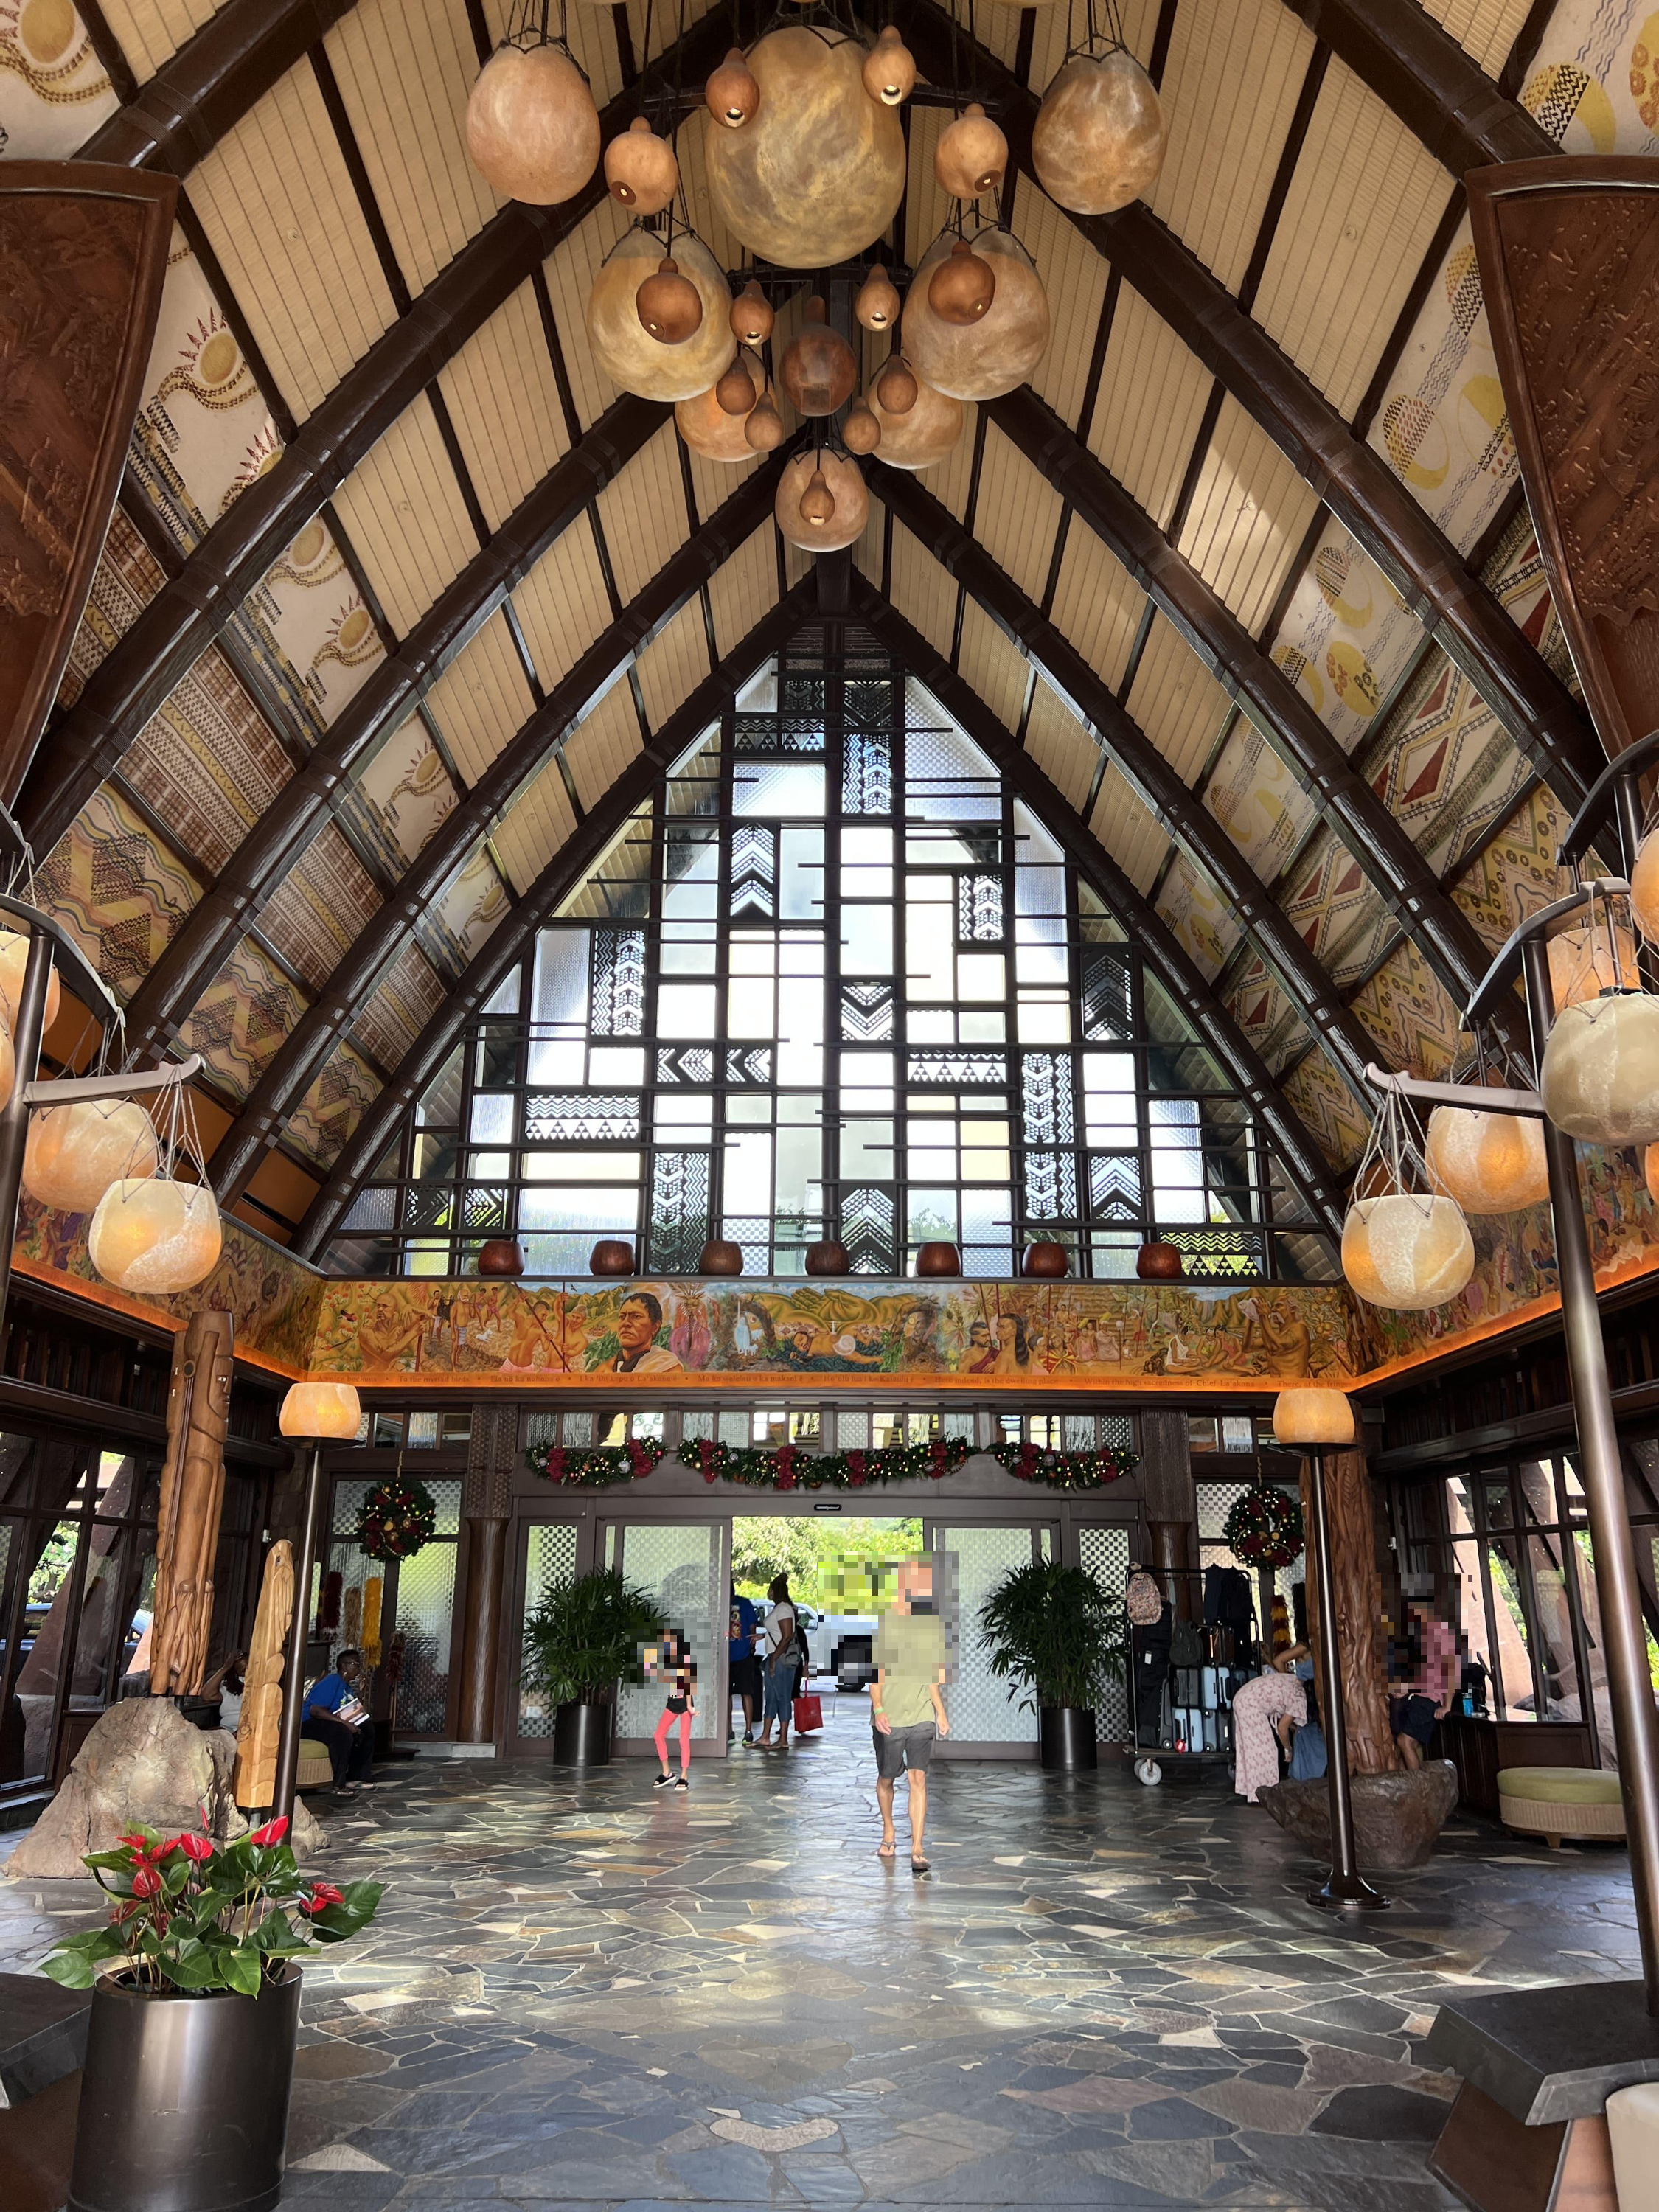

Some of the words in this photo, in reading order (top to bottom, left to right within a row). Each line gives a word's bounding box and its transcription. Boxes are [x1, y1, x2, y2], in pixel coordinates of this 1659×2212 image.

[955, 1377, 982, 1385] indeed,
[1005, 1377, 1037, 1385] dwelling
[1039, 1377, 1059, 1386] place
[1126, 1379, 1142, 1387] high
[1277, 1380, 1301, 1388] There,
